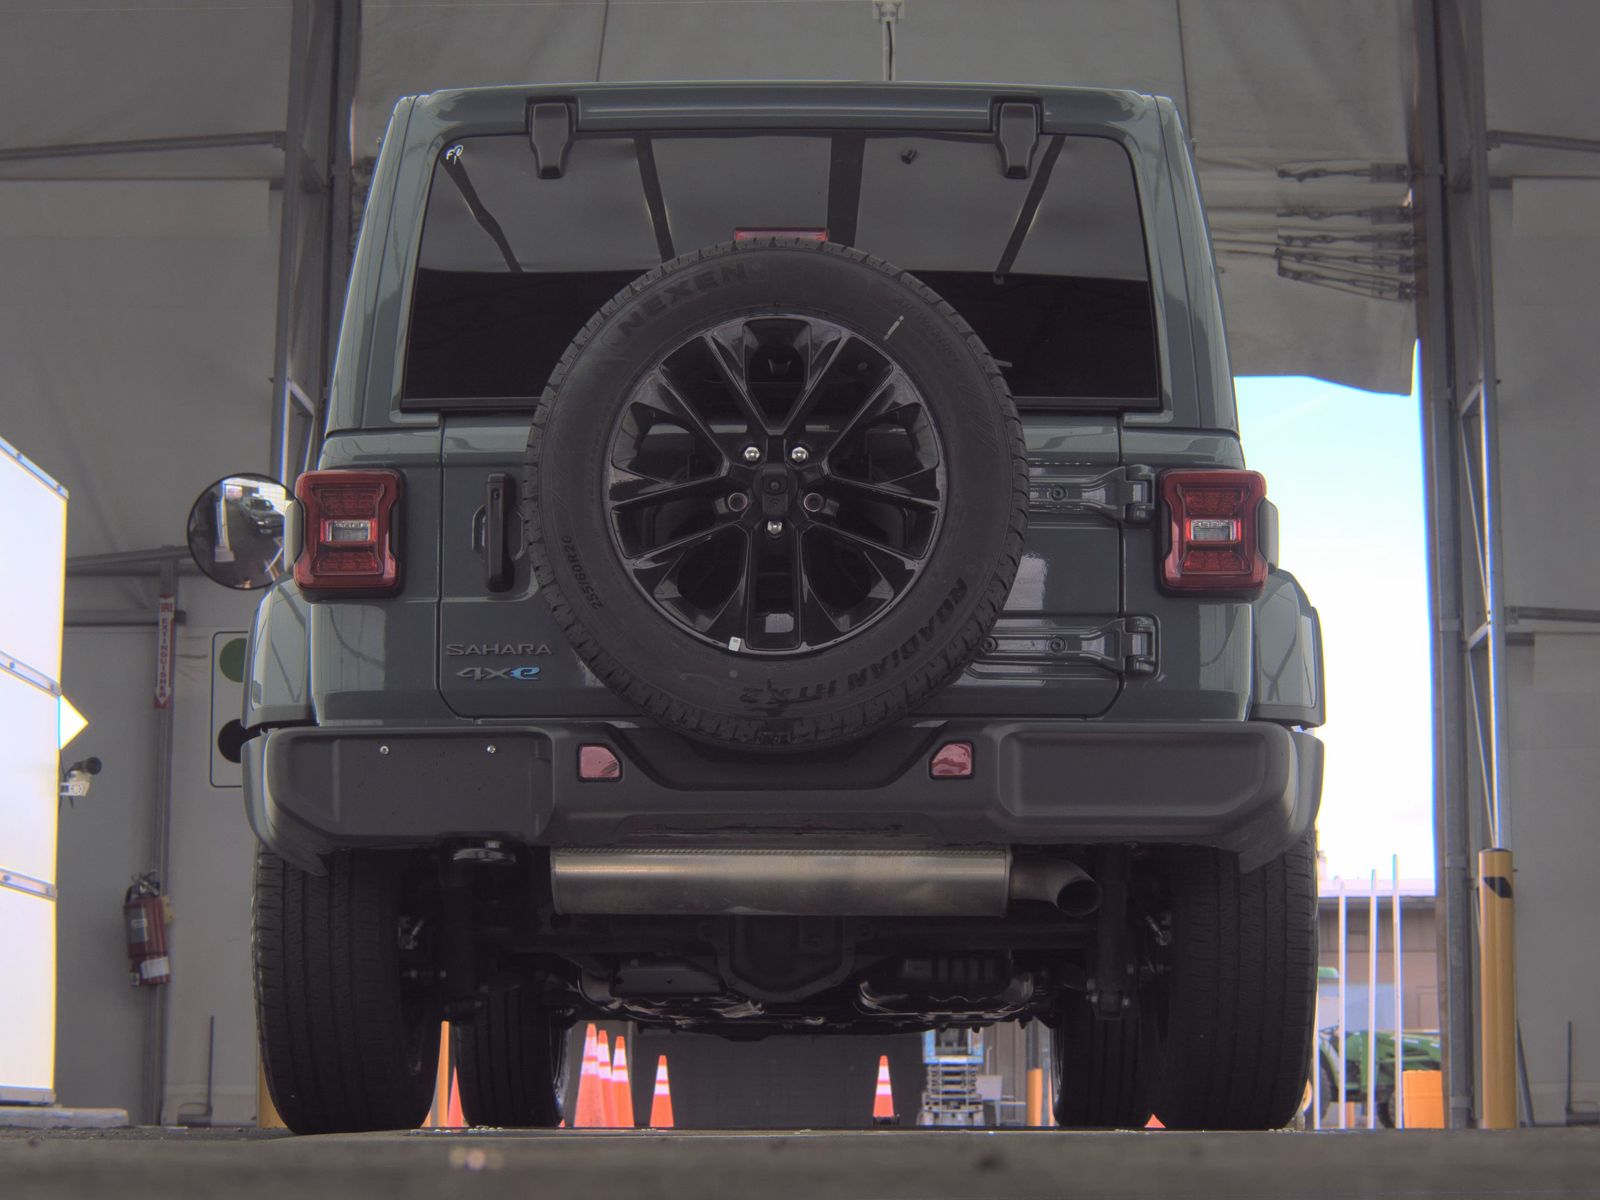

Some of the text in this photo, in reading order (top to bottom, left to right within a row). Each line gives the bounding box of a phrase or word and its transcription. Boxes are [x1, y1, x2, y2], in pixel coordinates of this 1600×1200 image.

[616, 262, 748, 337] NEXEN
[561, 535, 605, 611] 255/60R20
[446, 643, 552, 656] SAHARA
[847, 577, 968, 690] ROADIAN
